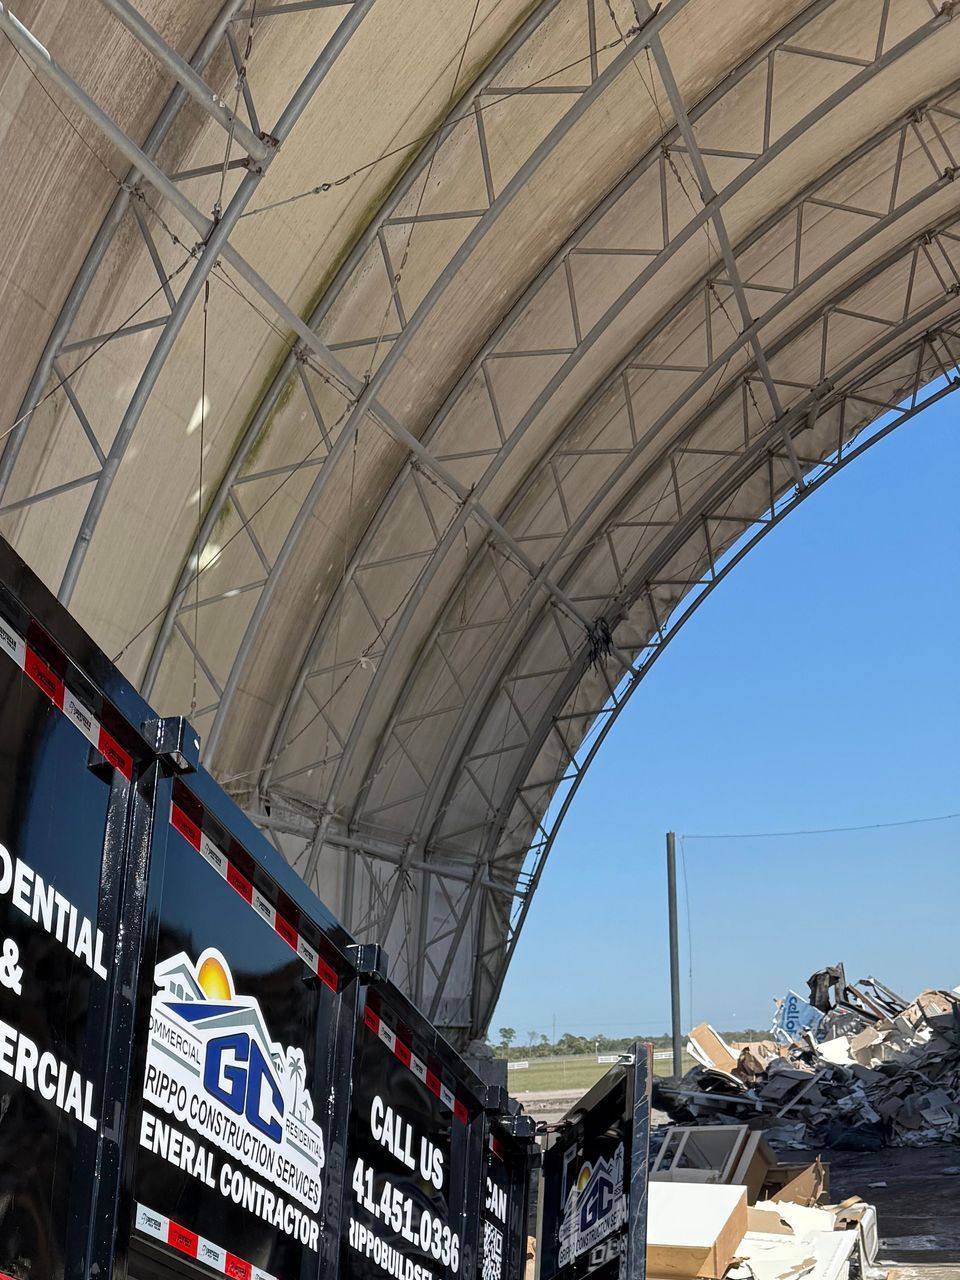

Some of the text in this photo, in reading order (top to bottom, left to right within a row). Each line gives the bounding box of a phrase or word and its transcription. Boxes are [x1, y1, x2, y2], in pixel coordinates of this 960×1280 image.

[145, 1064, 319, 1205] RIPPO CONSTRUCTION SERVICES
[203, 1032, 284, 1145] GC
[286, 1118, 322, 1160] RESIDENTIAL
[370, 1095, 444, 1190] CALL US
[140, 1110, 319, 1252] ENERAL CONTRACTOR
[352, 1157, 460, 1273] 41.451.0336
